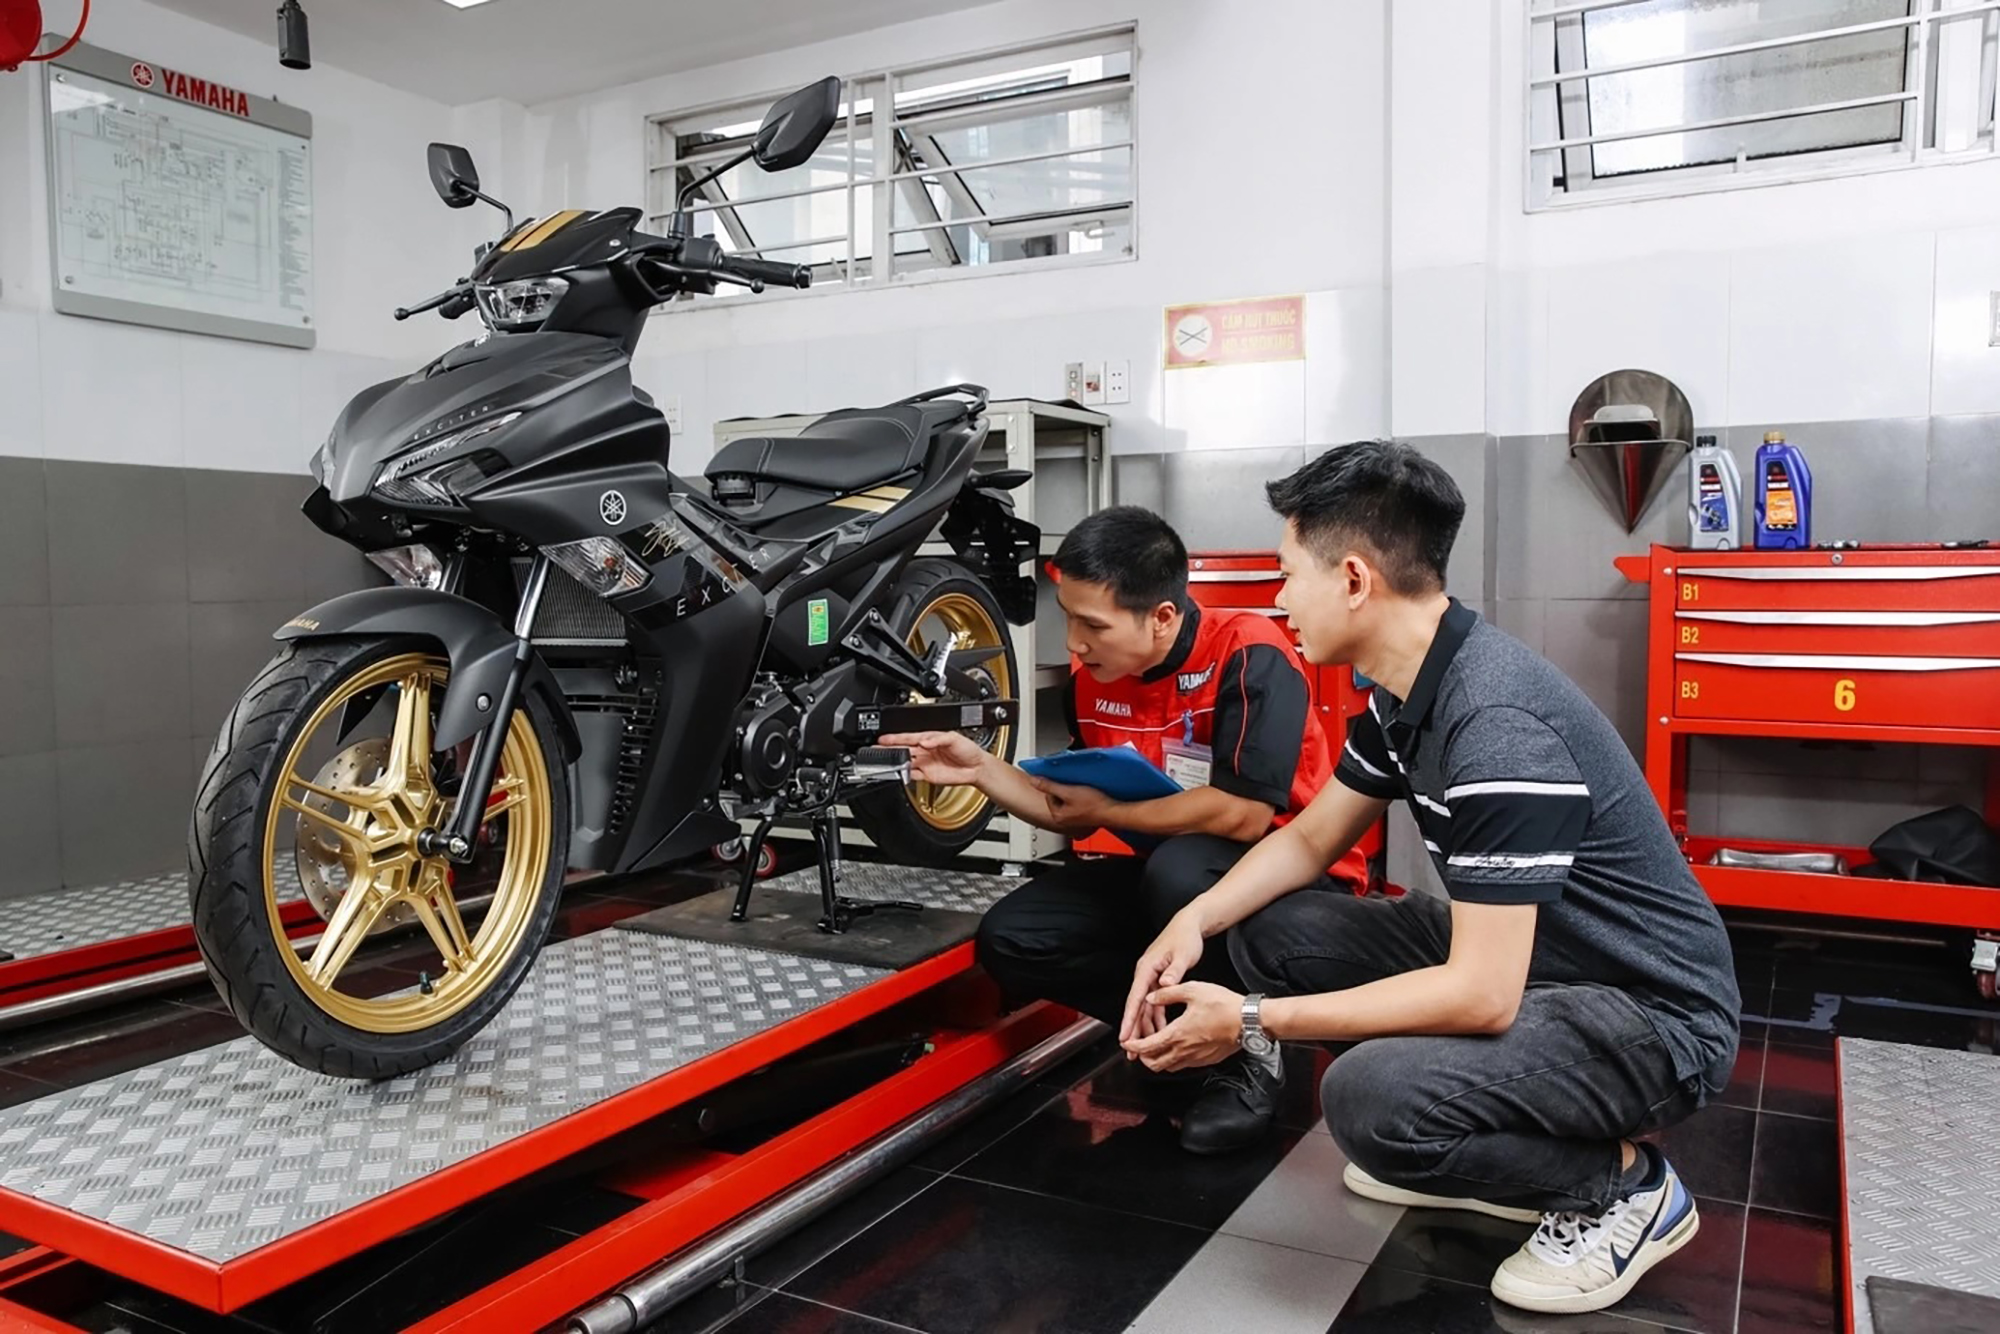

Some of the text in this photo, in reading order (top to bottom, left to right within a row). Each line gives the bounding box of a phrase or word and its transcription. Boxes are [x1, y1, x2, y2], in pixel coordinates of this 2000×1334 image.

[161, 68, 249, 118] YAMAHA
[1682, 583, 1699, 601] B1
[1681, 626, 1699, 644] B2
[1681, 680, 1699, 699] B3
[1834, 678, 1856, 711] 6
[1095, 698, 1132, 717] YAMAHA
